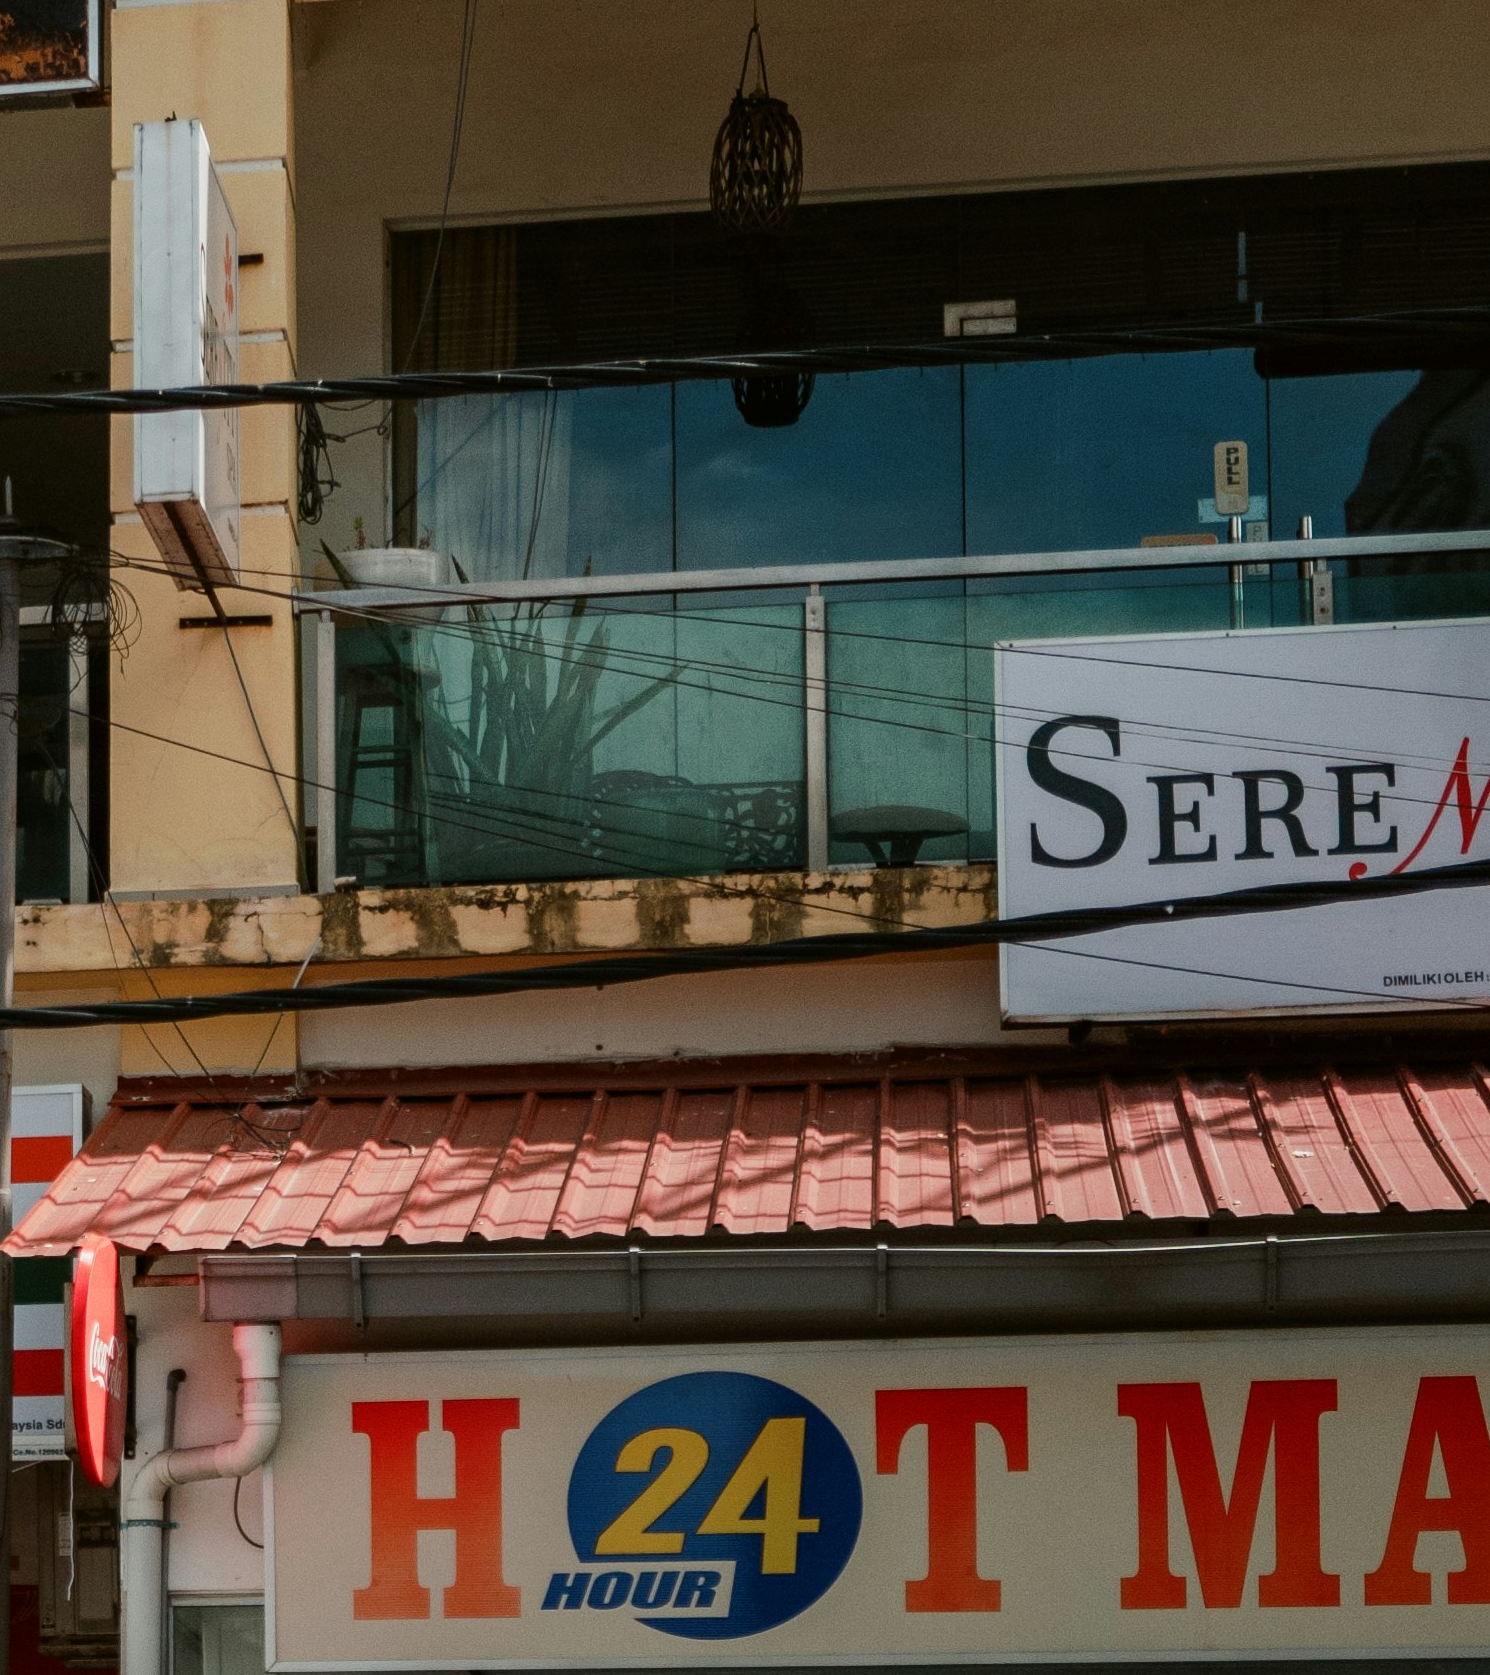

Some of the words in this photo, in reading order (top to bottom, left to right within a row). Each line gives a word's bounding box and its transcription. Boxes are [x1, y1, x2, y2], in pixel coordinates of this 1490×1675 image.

[1226, 447, 1240, 485] PULL
[1383, 972, 1441, 987] DIMILIKI
[594, 1416, 820, 1576] 24
[541, 1567, 724, 1615] HOUR
